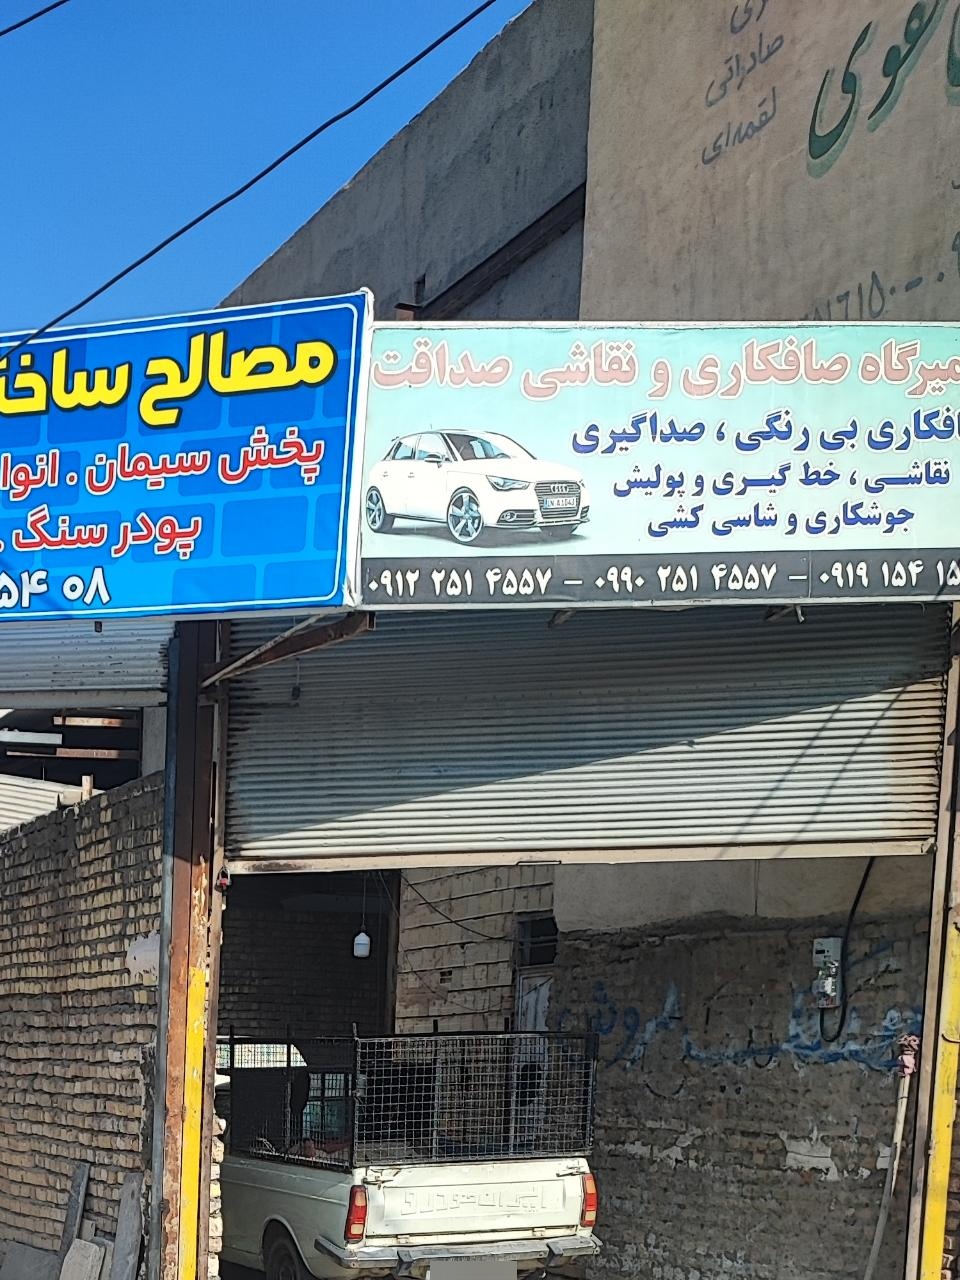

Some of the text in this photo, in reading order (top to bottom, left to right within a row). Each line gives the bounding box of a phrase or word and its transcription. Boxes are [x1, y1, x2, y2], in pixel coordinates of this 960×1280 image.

[141, 333, 335, 427] مصالح
[372, 335, 960, 401] میرگاه صافکاری و نقاشی صداقت
[572, 411, 706, 454] صداگیری
[819, 417, 858, 451] بی
[87, 444, 210, 496] سیمان
[219, 427, 324, 485] پخش
[798, 461, 841, 486] خط
[613, 464, 685, 498] پولیش
[694, 474, 706, 497] و
[711, 463, 792, 497] گیری
[14, 505, 107, 551] سنگ
[111, 511, 202, 559] پودر
[648, 501, 915, 539] جوشکاری و شاسی کشی
[62, 566, 112, 605] ۰۸
[368, 568, 420, 597] ۰۹۱۲
[431, 568, 473, 597] ۲۵۱
[485, 567, 553, 596] ۴۵۵۷
[594, 565, 646, 593] ۰۹۹۰
[656, 564, 699, 592] ۲۵۱
[711, 563, 777, 591] ۴۵۵۷
[819, 560, 870, 588] ۰۹۱۹
[880, 559, 924, 588] ۱۵۴
[935, 560, 960, 588] ۱۵
